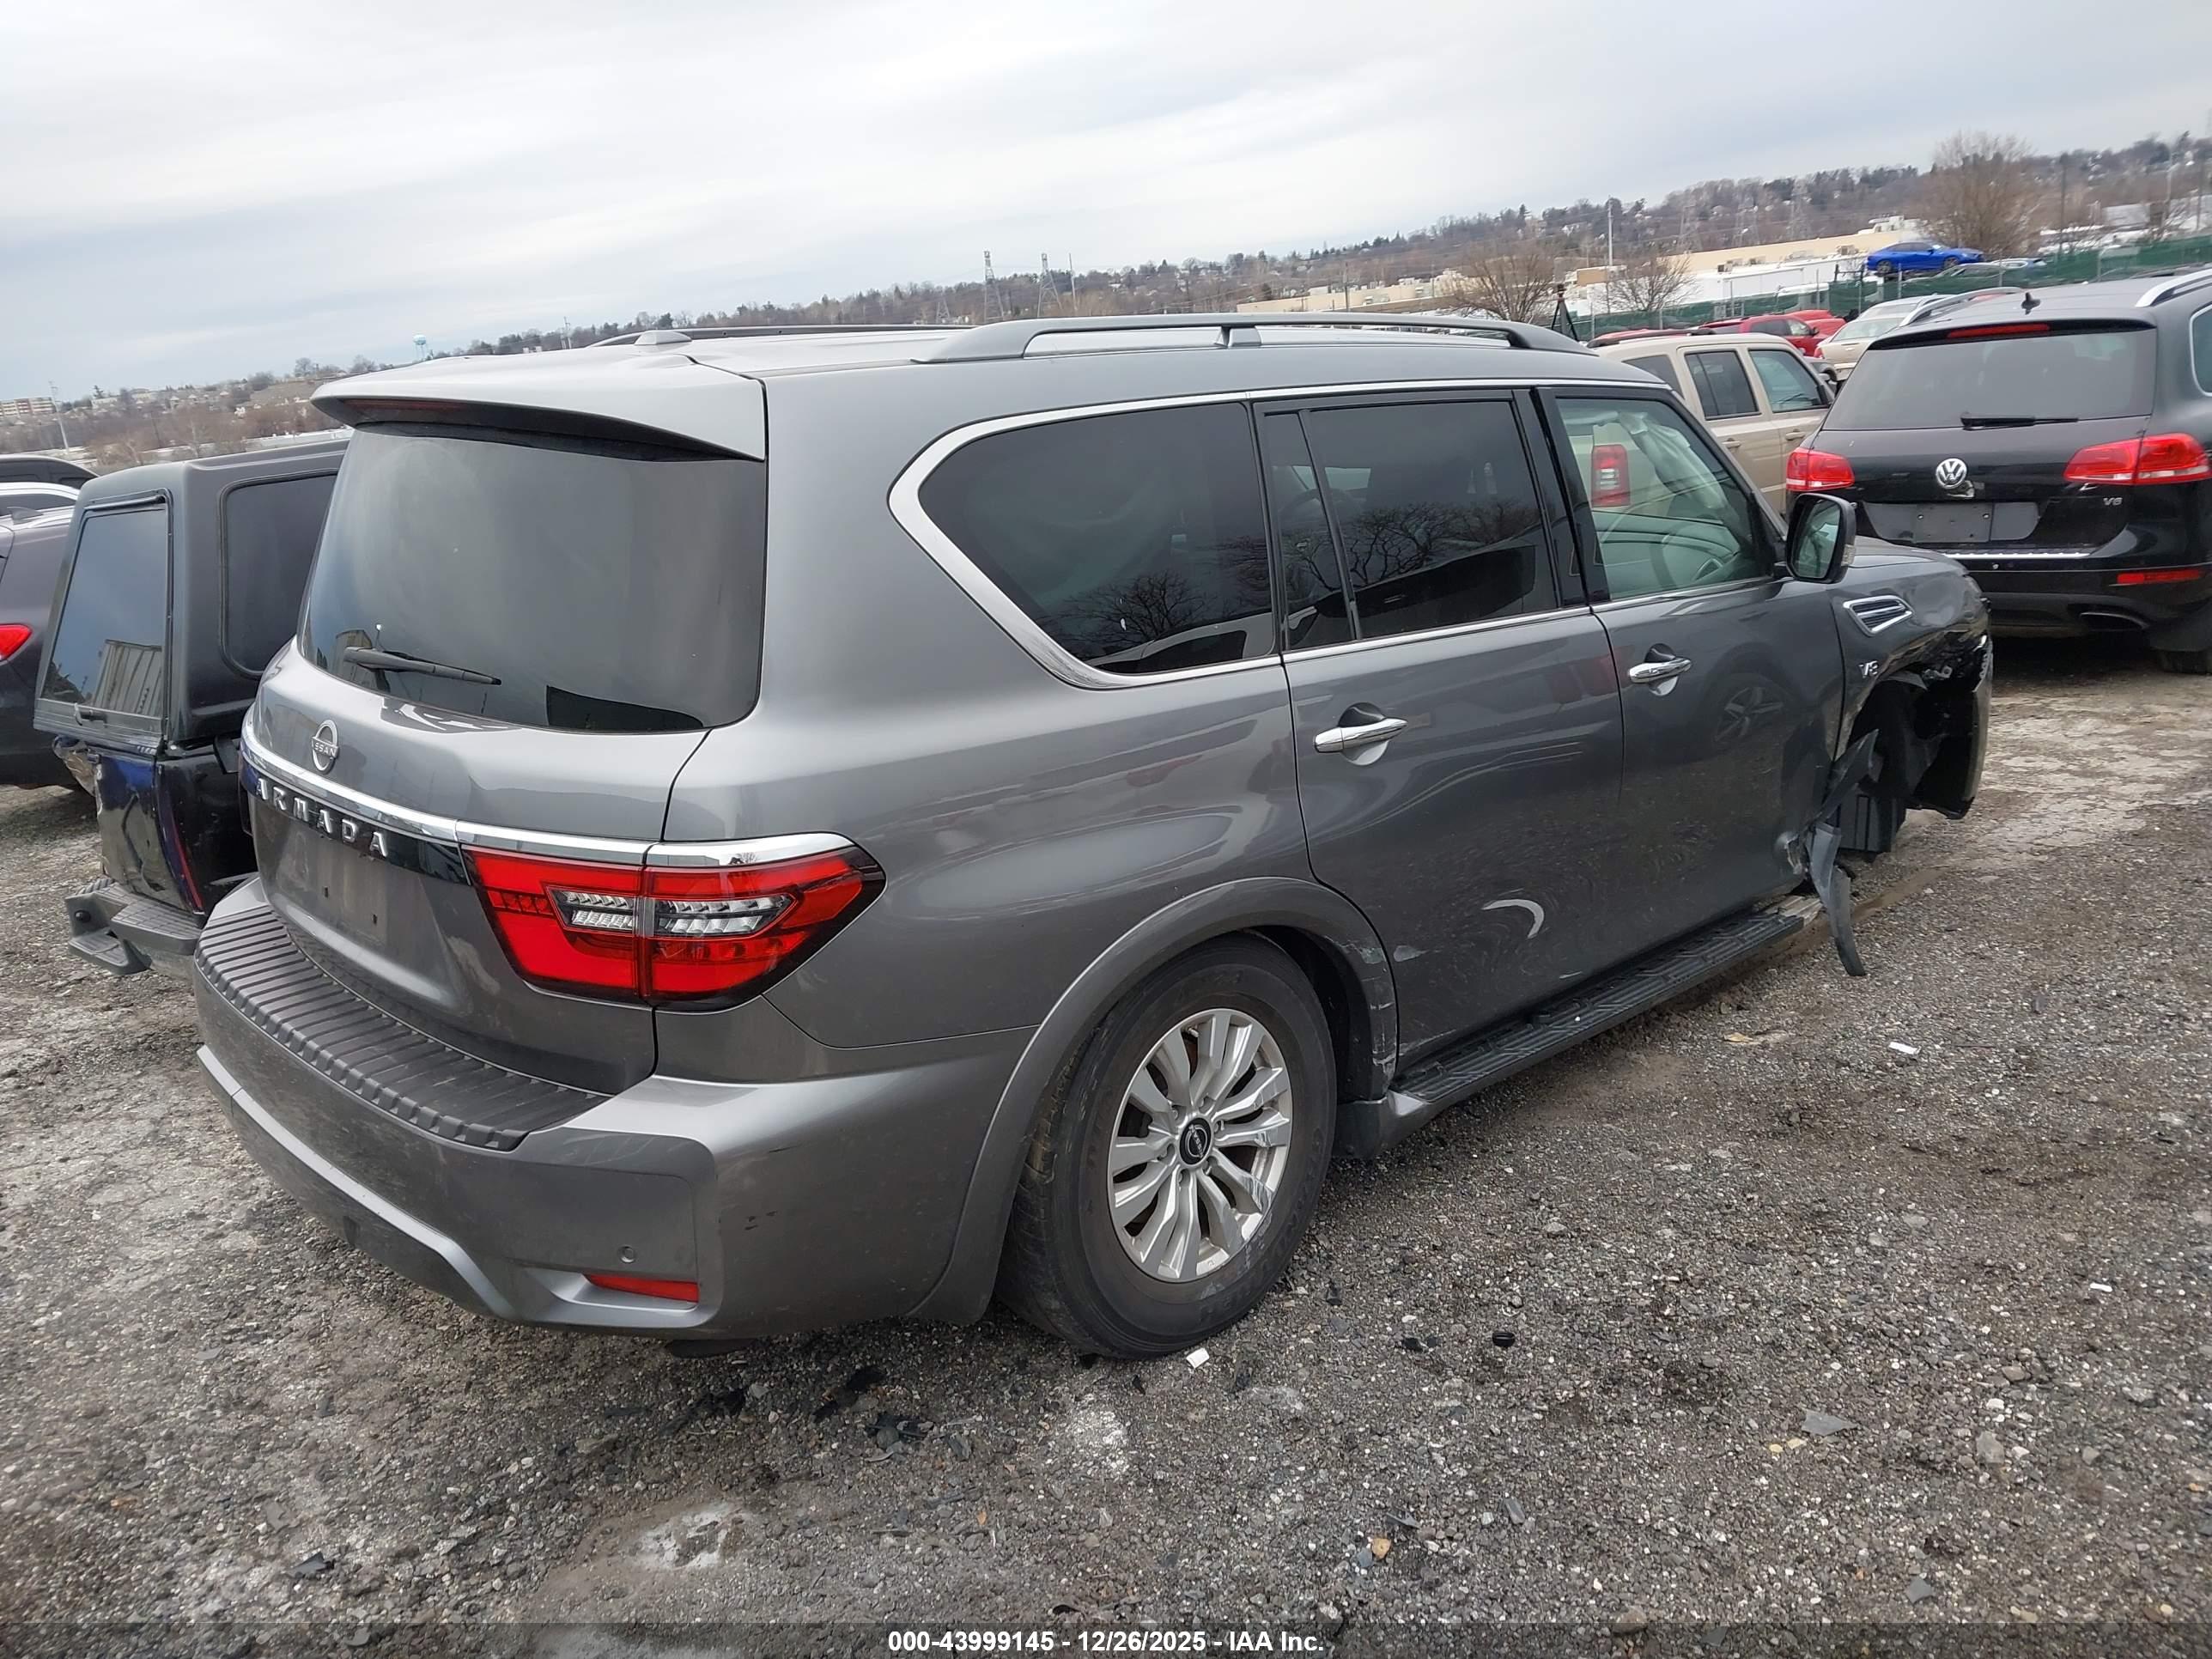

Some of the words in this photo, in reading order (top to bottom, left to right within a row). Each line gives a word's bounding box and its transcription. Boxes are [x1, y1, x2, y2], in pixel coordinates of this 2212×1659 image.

[1936, 458, 1967, 489] VW
[2103, 497, 2123, 506] V6
[311, 738, 337, 758] ISSAN
[257, 778, 388, 858] ARMADA
